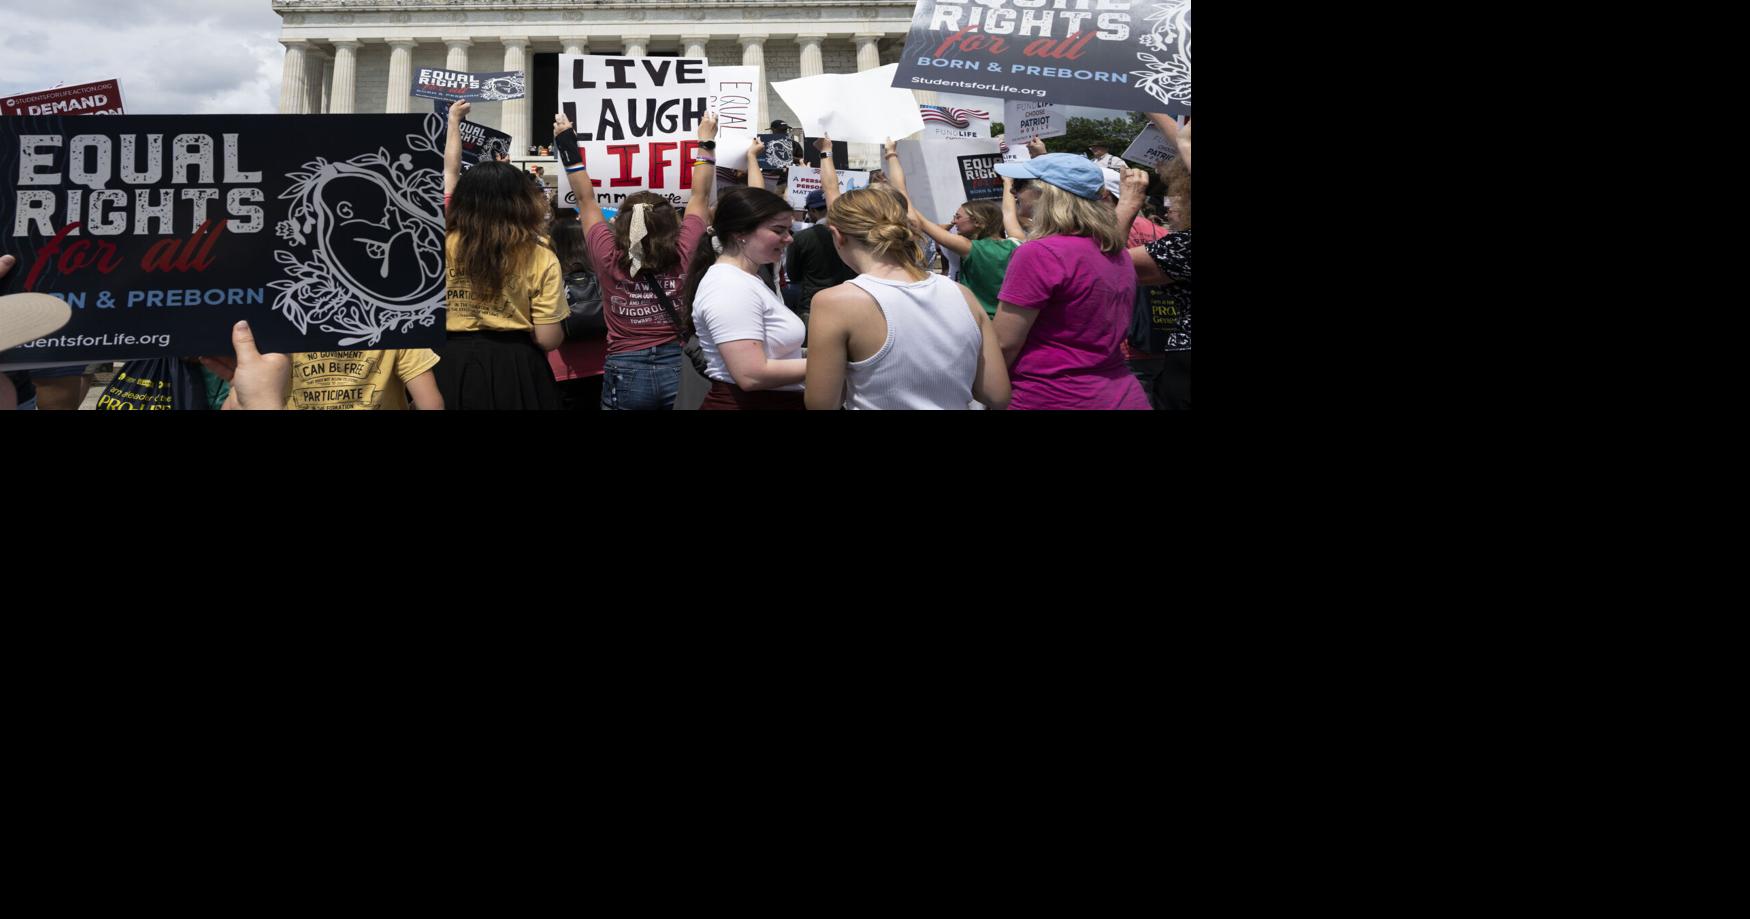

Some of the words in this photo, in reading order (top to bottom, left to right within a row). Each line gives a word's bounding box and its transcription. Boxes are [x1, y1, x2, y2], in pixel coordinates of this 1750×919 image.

[928, 4, 1131, 41] RIGHTS
[934, 23, 1010, 58] for
[1023, 29, 1098, 60] all
[420, 69, 480, 83] EQUAL
[573, 58, 706, 89] LIVE
[917, 57, 979, 71] BORN
[987, 62, 1002, 73] &
[1011, 64, 1128, 84] PREBORN
[418, 77, 480, 89] RIGHTS
[911, 76, 1047, 98] StudentsforLife.org
[28, 94, 108, 115] DEMAND
[459, 122, 486, 138] QUAL
[562, 97, 707, 141] LAUGH
[1020, 116, 1050, 128] PATRIOT
[17, 133, 262, 189] EQUAL
[965, 168, 997, 181] RIGH
[12, 187, 264, 237] RIGHTS
[24, 220, 125, 292] for
[140, 218, 229, 273] all
[634, 280, 676, 291] AWKEN
[96, 290, 116, 309] &
[127, 287, 264, 309] PREBORN
[302, 362, 325, 377] CAN
[329, 361, 342, 373] BE
[344, 363, 365, 376] FREE
[303, 388, 363, 402] PARTICIPATE
